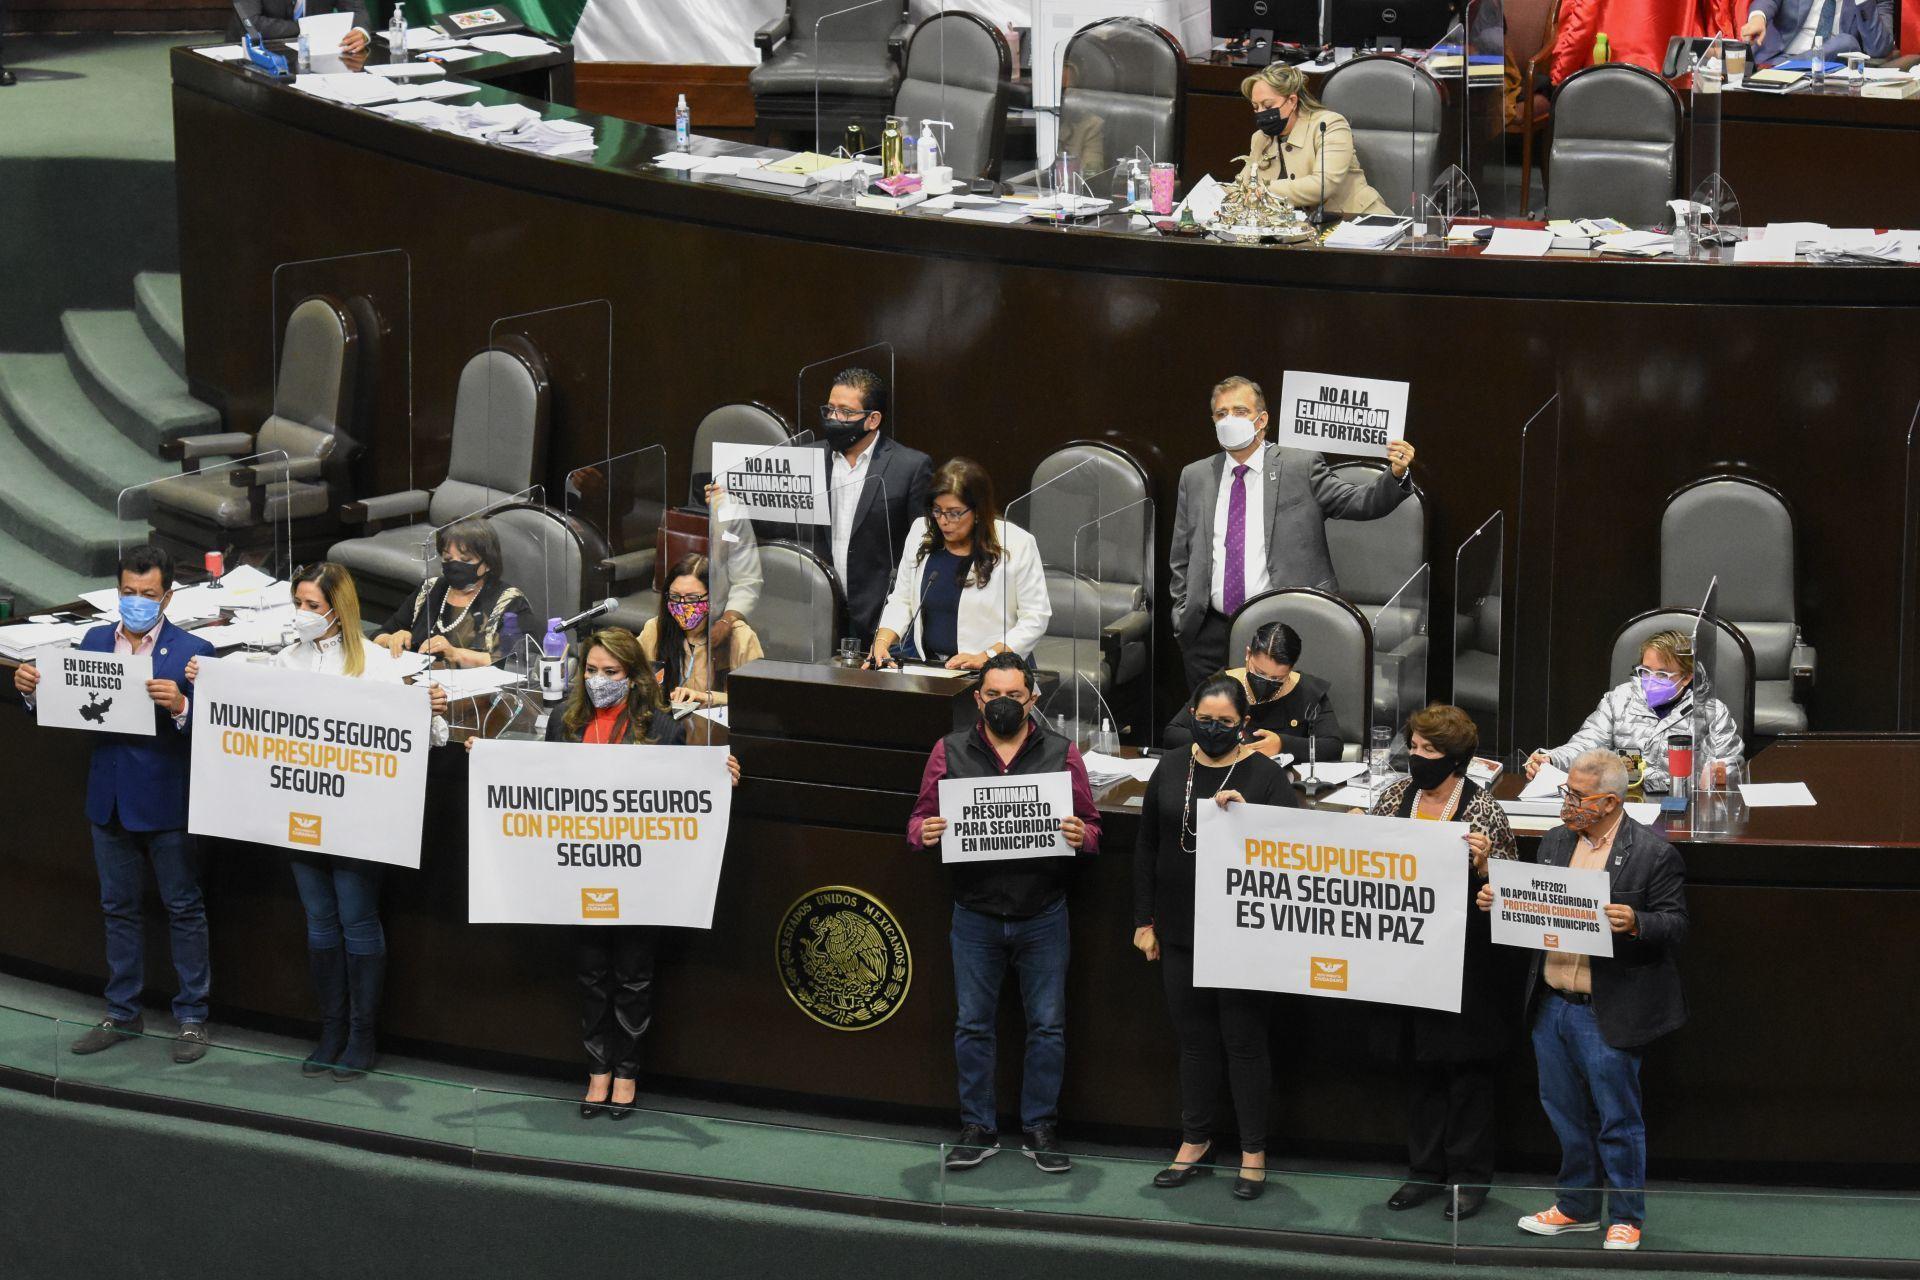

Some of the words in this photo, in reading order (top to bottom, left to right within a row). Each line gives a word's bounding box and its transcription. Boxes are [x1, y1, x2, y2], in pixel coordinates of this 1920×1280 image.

[1319, 386, 1338, 403] NO
[1340, 389, 1349, 405] A
[1352, 390, 1368, 407] LA
[1298, 400, 1387, 428] ELIMINACIÓN
[1294, 419, 1318, 436] DEL
[1321, 423, 1387, 445] FORTASEG
[745, 457, 762, 473] NO
[765, 458, 773, 473] A
[775, 459, 791, 474] LA
[752, 493, 814, 510] FORTASEG
[63, 658, 77, 672] EN
[79, 659, 124, 676] DEFENSA
[65, 673, 78, 686] DE
[80, 674, 122, 690] JALISCO
[210, 701, 319, 740] MUNICIPIOS
[323, 718, 412, 753] SEGUROS
[222, 730, 258, 758] CON
[262, 737, 398, 779] PRESUPUESTO
[270, 765, 345, 798] SEGURO
[487, 784, 608, 813] MUNICIPIOS
[612, 789, 713, 814] SEGUROS
[975, 786, 1037, 804] ELIMINAN
[963, 802, 1051, 820] PRESUPUESTO
[502, 812, 542, 838] CON
[548, 814, 698, 841] PRESUPUESTO
[954, 821, 988, 836] PARA
[991, 818, 1061, 835] SEGURIDAD
[962, 838, 977, 852] EN
[980, 834, 1055, 852] MUNICIPIOS
[557, 842, 642, 868] SEGURO
[1245, 838, 1417, 882] PRESUPUESTO
[1226, 867, 1292, 901] PARA
[1297, 874, 1435, 915] SEGURIDAD
[1531, 878, 1567, 893] #PEF2021
[1500, 887, 1511, 898] NO
[1512, 888, 1537, 902] APOYA
[1538, 892, 1548, 903] LA
[1549, 893, 1593, 909] SEGURIDAD
[1594, 900, 1599, 909] Y
[1503, 899, 1551, 915] PROTECCIÓN
[1551, 905, 1597, 921] CIUDADANA
[782, 902, 812, 947] ESTADOS
[816, 893, 858, 907] UNIDOS
[863, 903, 906, 967] MEXICANOS
[1236, 900, 1265, 929] ES
[1270, 903, 1335, 936] VIVIR
[1341, 910, 1372, 939] EN
[1378, 914, 1425, 945] PAZ
[1502, 911, 1511, 921] EN
[1512, 912, 1545, 926] ESTADOS
[1546, 917, 1552, 926] Y
[1553, 918, 1600, 933] MUNICIPIOS
